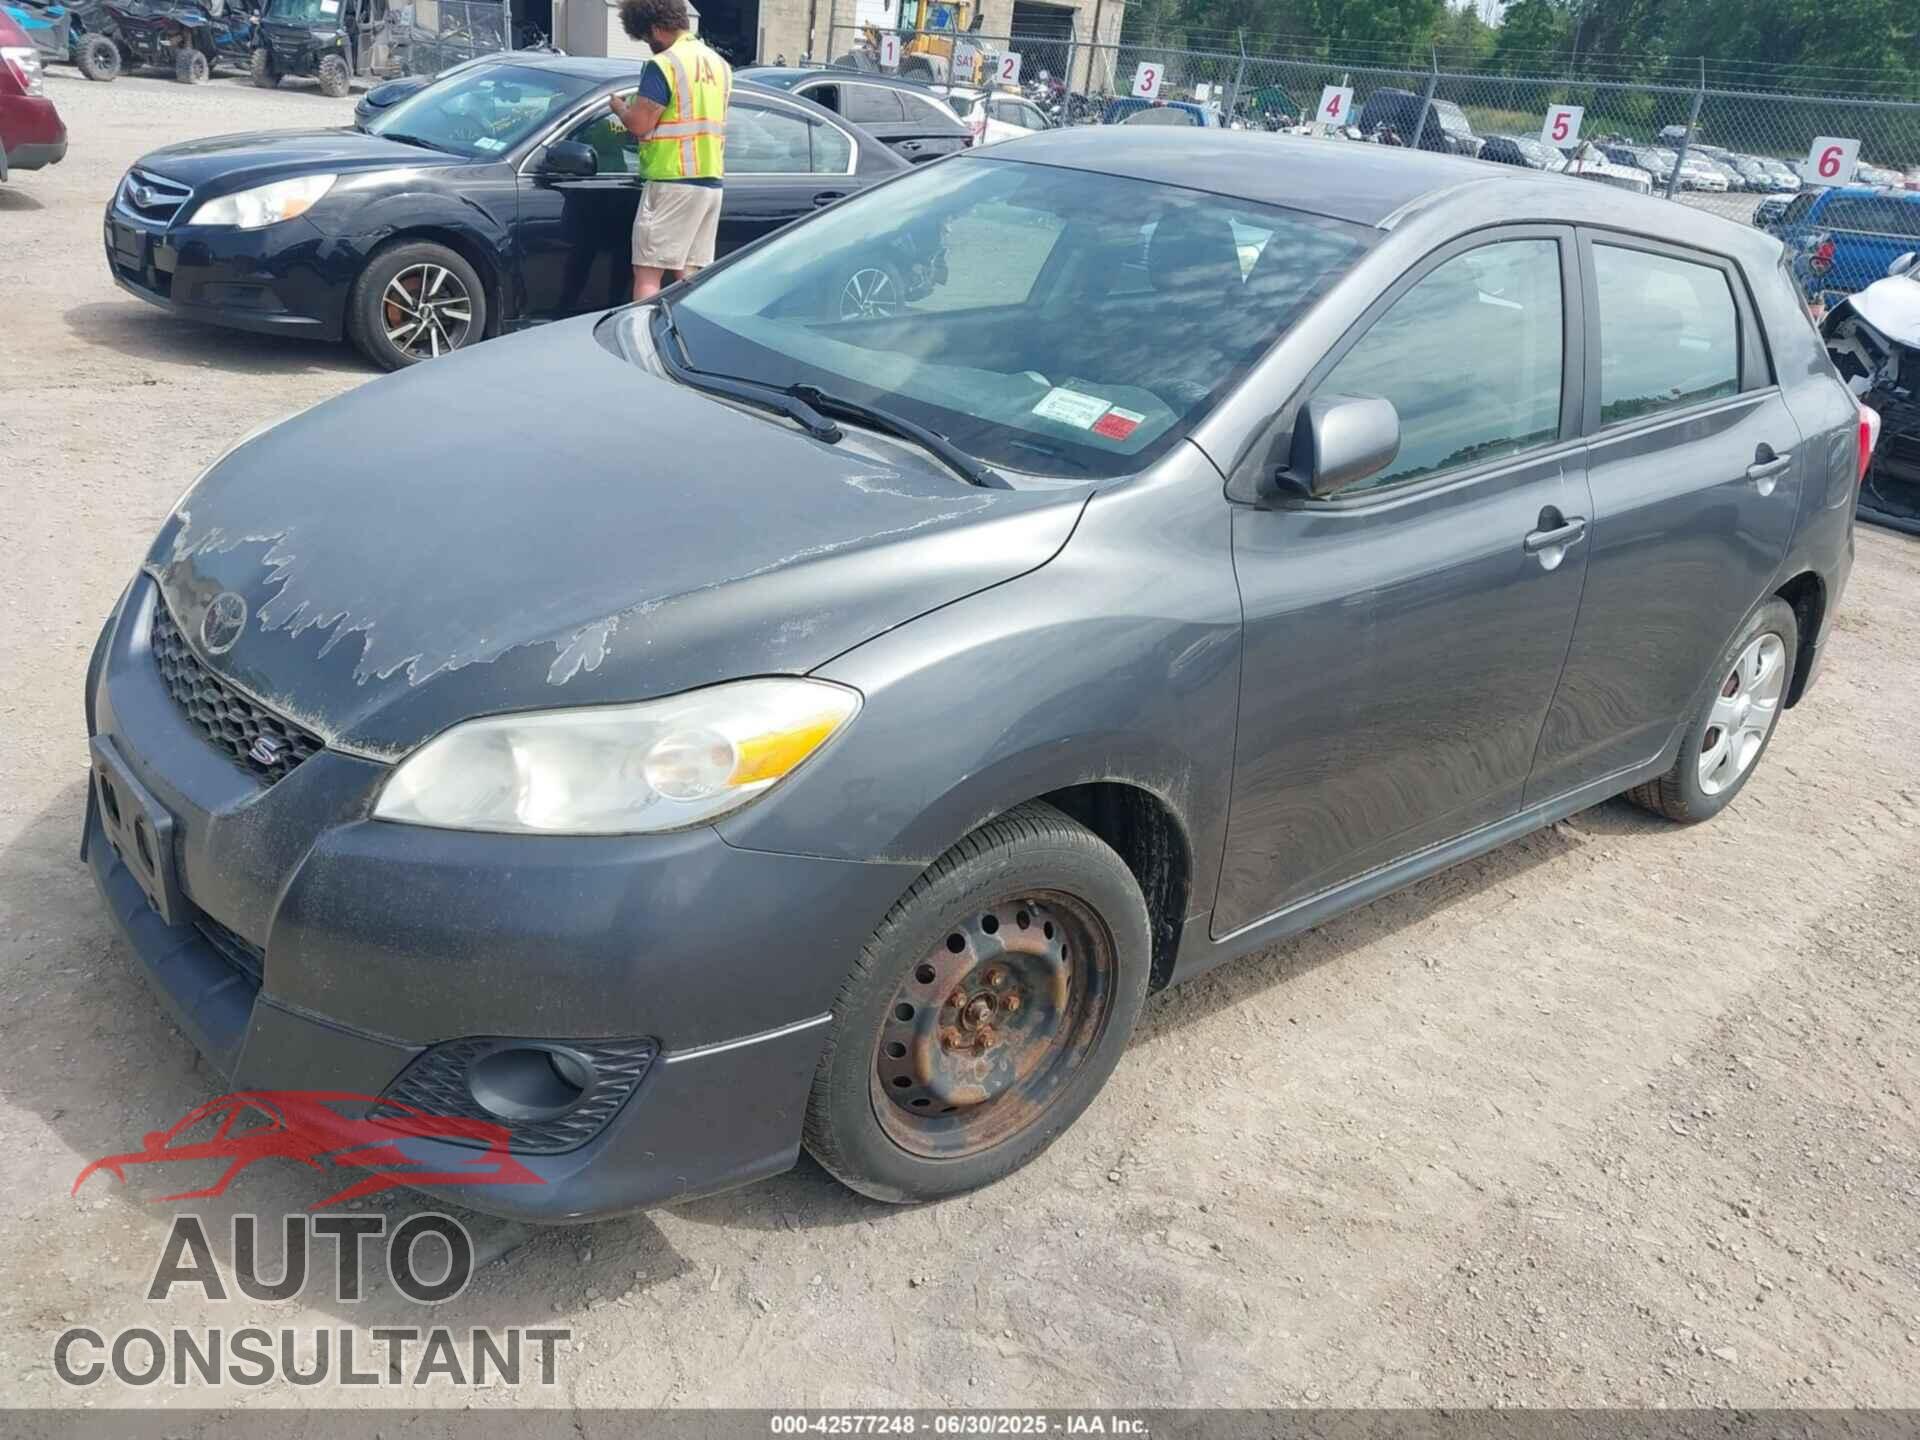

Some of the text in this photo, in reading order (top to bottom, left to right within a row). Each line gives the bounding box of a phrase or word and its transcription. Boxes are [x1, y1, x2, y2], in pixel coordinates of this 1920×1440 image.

[886, 41, 893, 61] 1
[1002, 58, 1014, 80] 2
[1140, 69, 1155, 92] 3
[1326, 94, 1341, 117] 4
[1552, 112, 1571, 141] 5
[1818, 146, 1843, 178] 6
[249, 737, 277, 765] S
